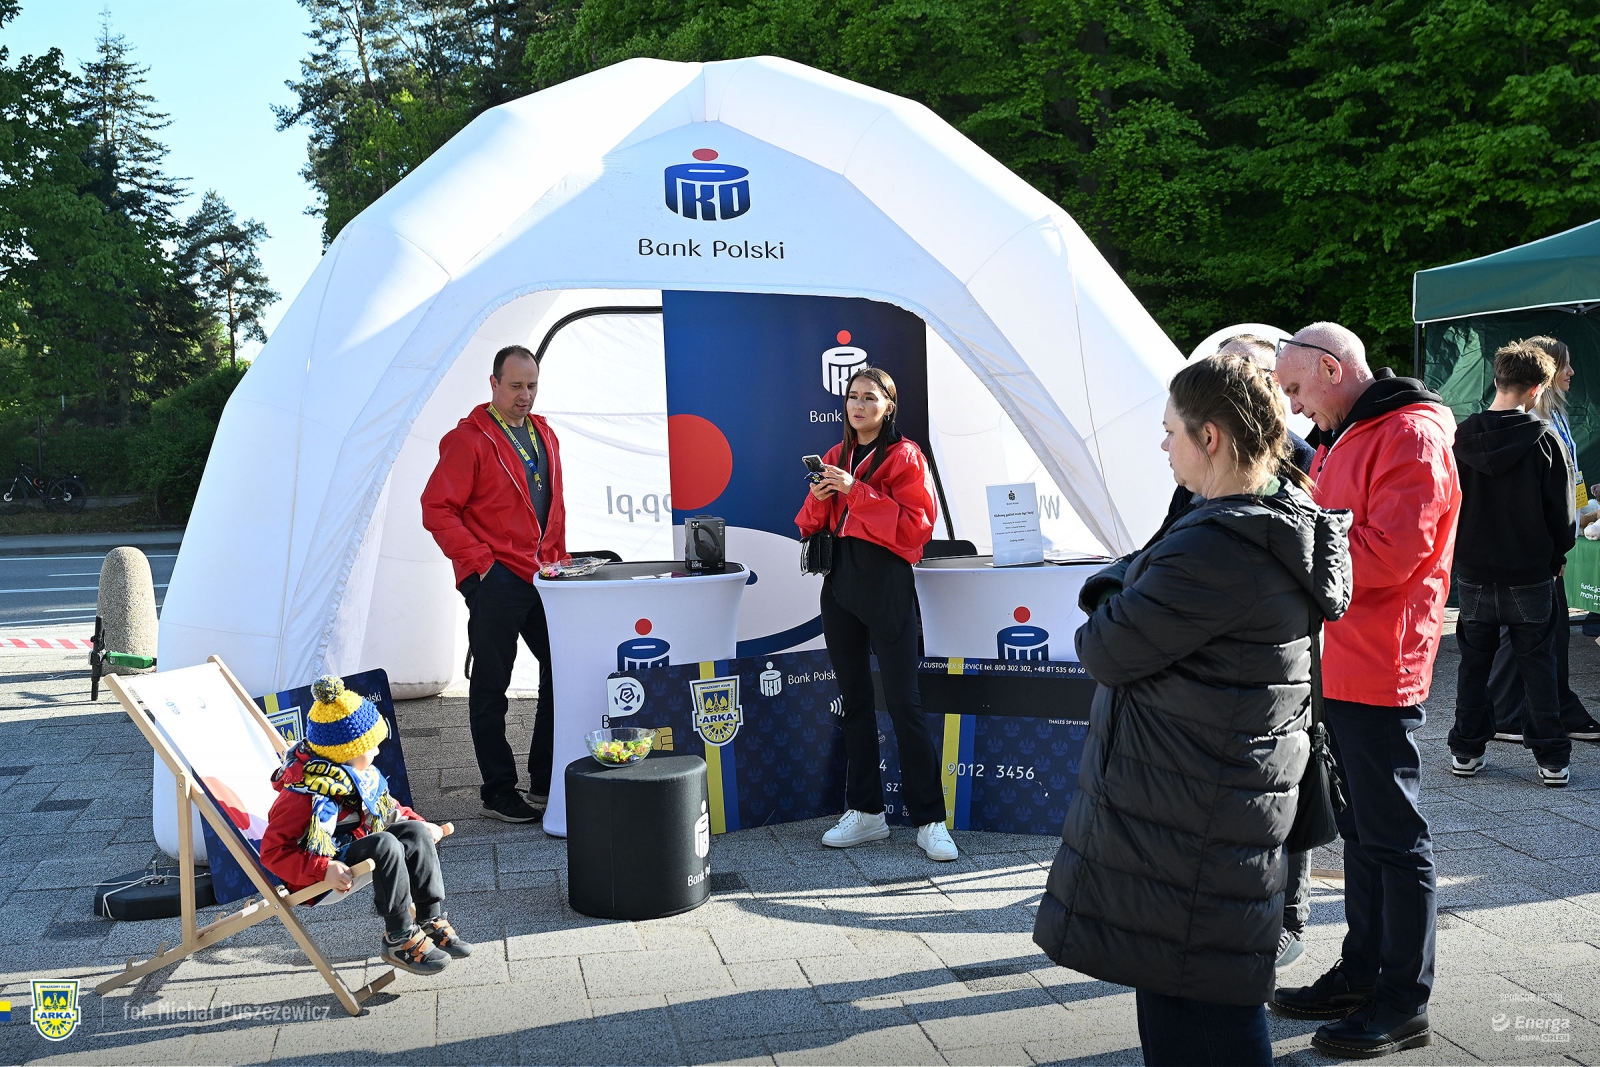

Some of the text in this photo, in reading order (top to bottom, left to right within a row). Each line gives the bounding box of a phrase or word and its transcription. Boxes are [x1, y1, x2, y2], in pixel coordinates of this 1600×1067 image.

[664, 163, 751, 221] PKO
[638, 238, 785, 260] Bank Polski
[809, 409, 843, 423] Bank
[923, 661, 957, 669] CUSTOMER
[958, 662, 983, 671] SERVICE
[759, 669, 838, 697] PKO Bank Polsk
[702, 713, 734, 723] ARKA
[947, 763, 1035, 780] 9012 3456
[687, 869, 705, 887] Bank
